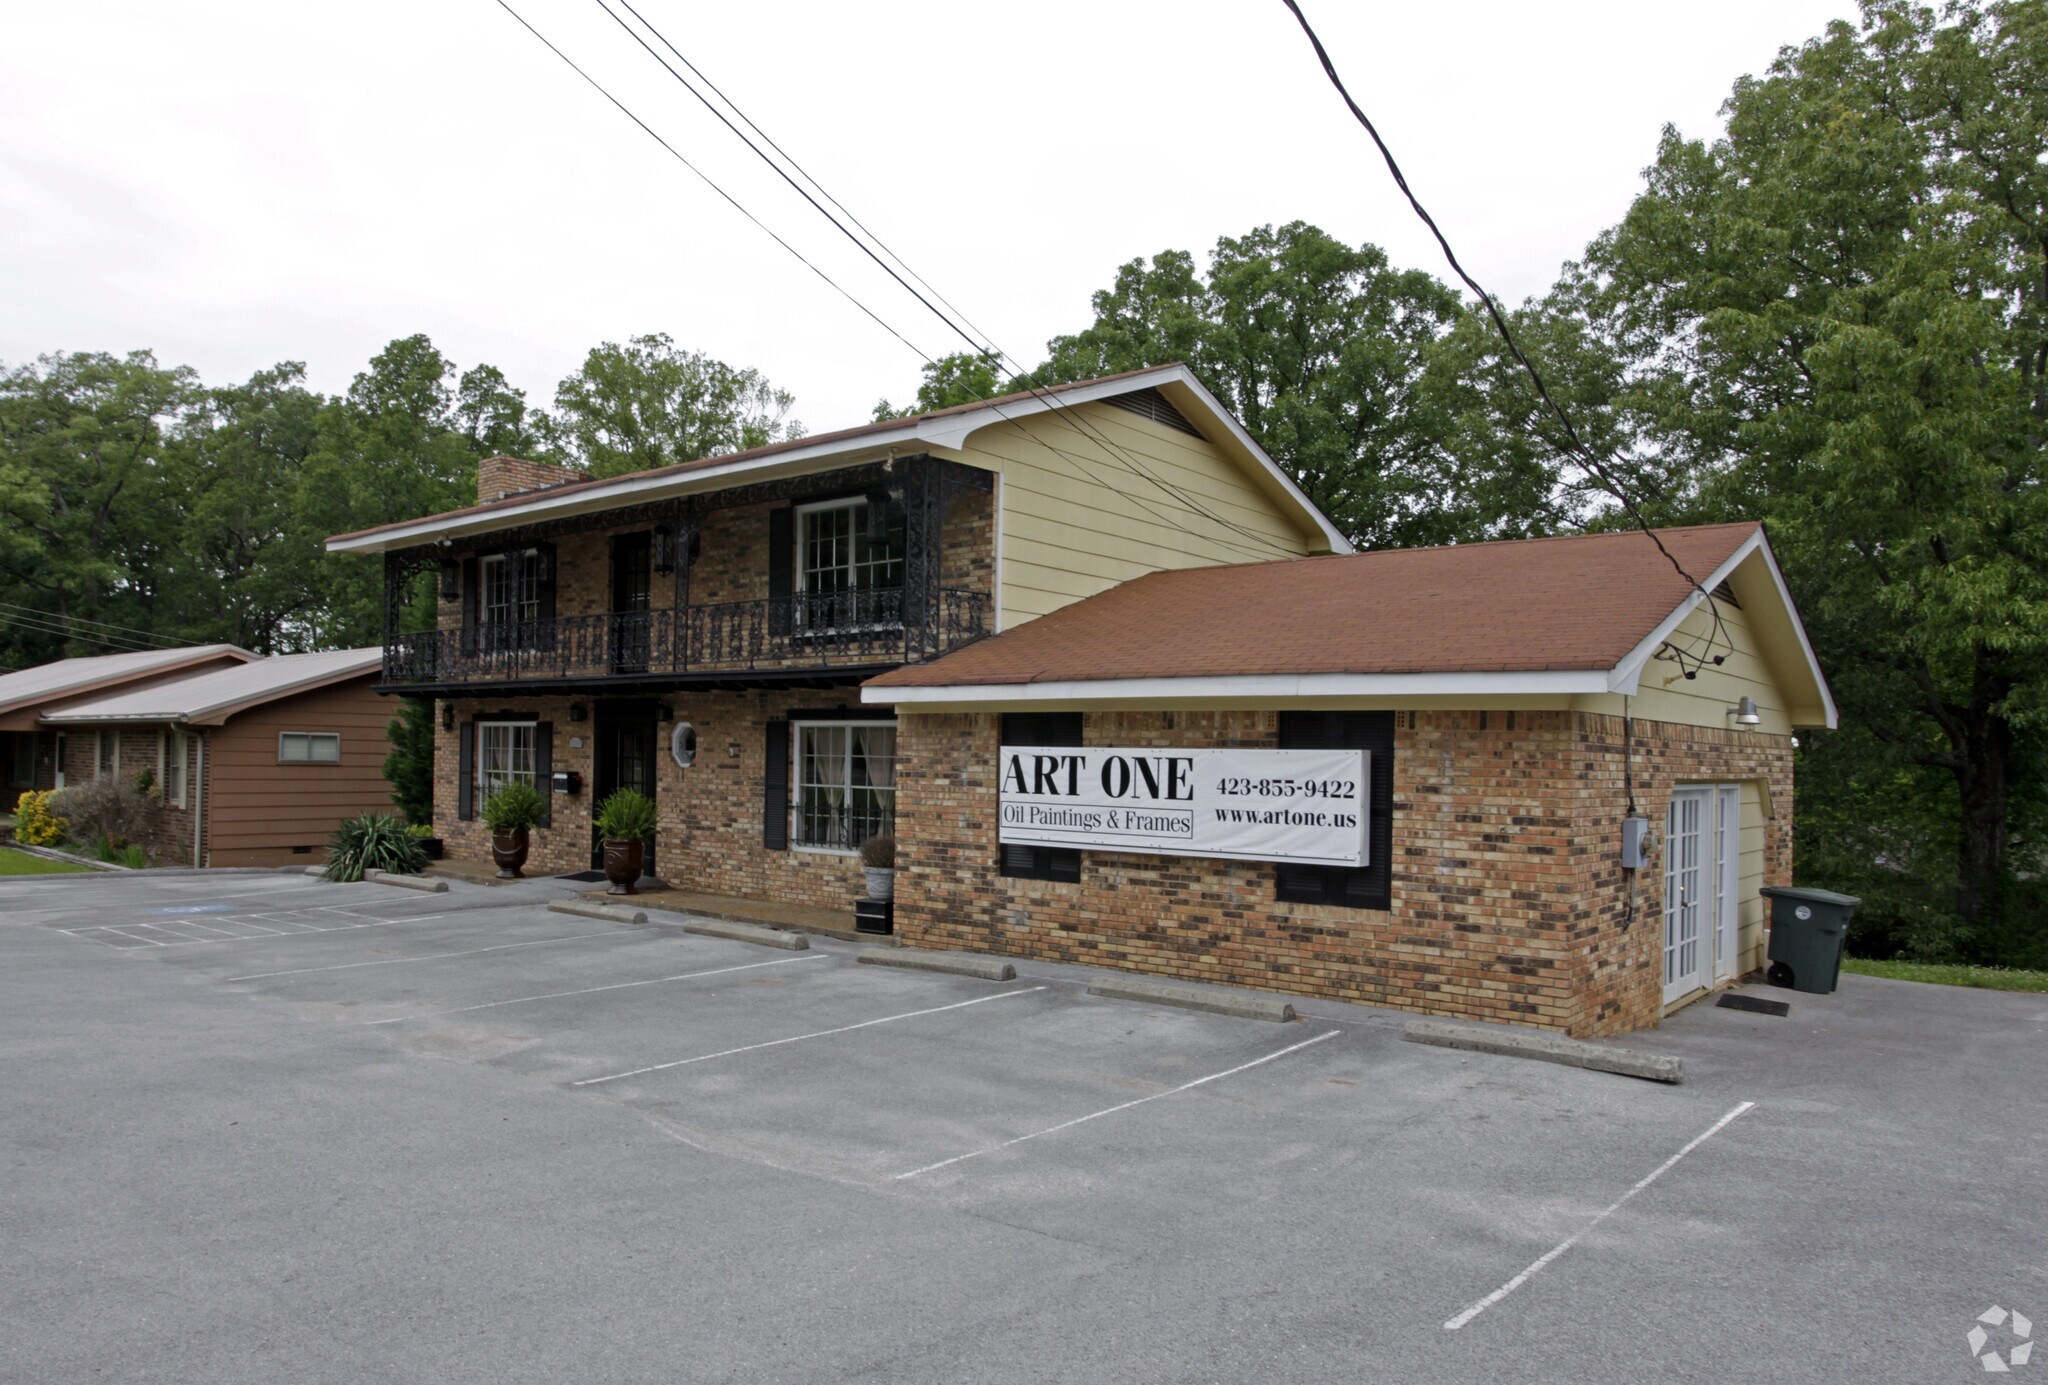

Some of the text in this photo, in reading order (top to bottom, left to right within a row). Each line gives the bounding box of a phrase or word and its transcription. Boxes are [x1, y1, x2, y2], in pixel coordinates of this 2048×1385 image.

[1000, 754, 1194, 801] ART ONE
[1216, 777, 1355, 799] 423-855-9422
[1003, 804, 1191, 833] Oil Paintings & Frames
[1215, 807, 1357, 828] www.artone.us
